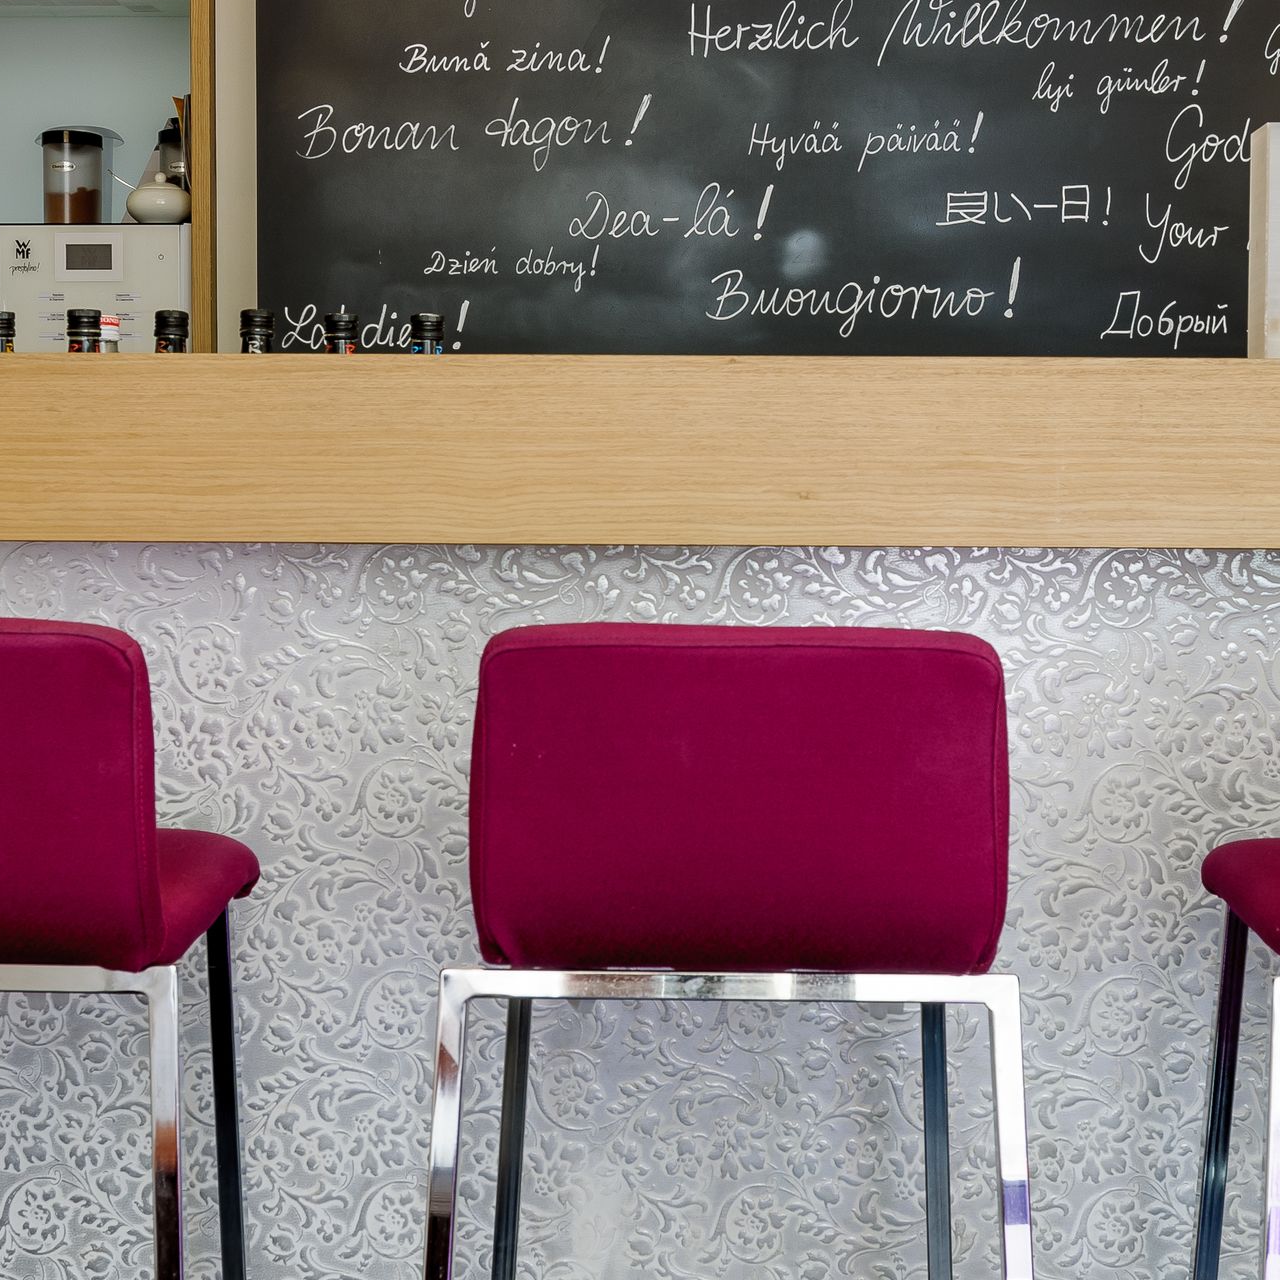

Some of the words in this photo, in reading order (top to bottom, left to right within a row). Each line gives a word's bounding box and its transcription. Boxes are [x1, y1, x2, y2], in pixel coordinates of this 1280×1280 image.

[1097, 59, 1206, 114] günler!
[298, 105, 459, 159] Bonan
[748, 121, 842, 171] Hyvää
[858, 111, 983, 172] päivää!
[1139, 193, 1229, 263] Your
[424, 247, 498, 275] Dzień
[516, 245, 599, 292] dobry!
[706, 257, 1021, 337] Buongiorno!
[1100, 291, 1228, 349] Добрый
